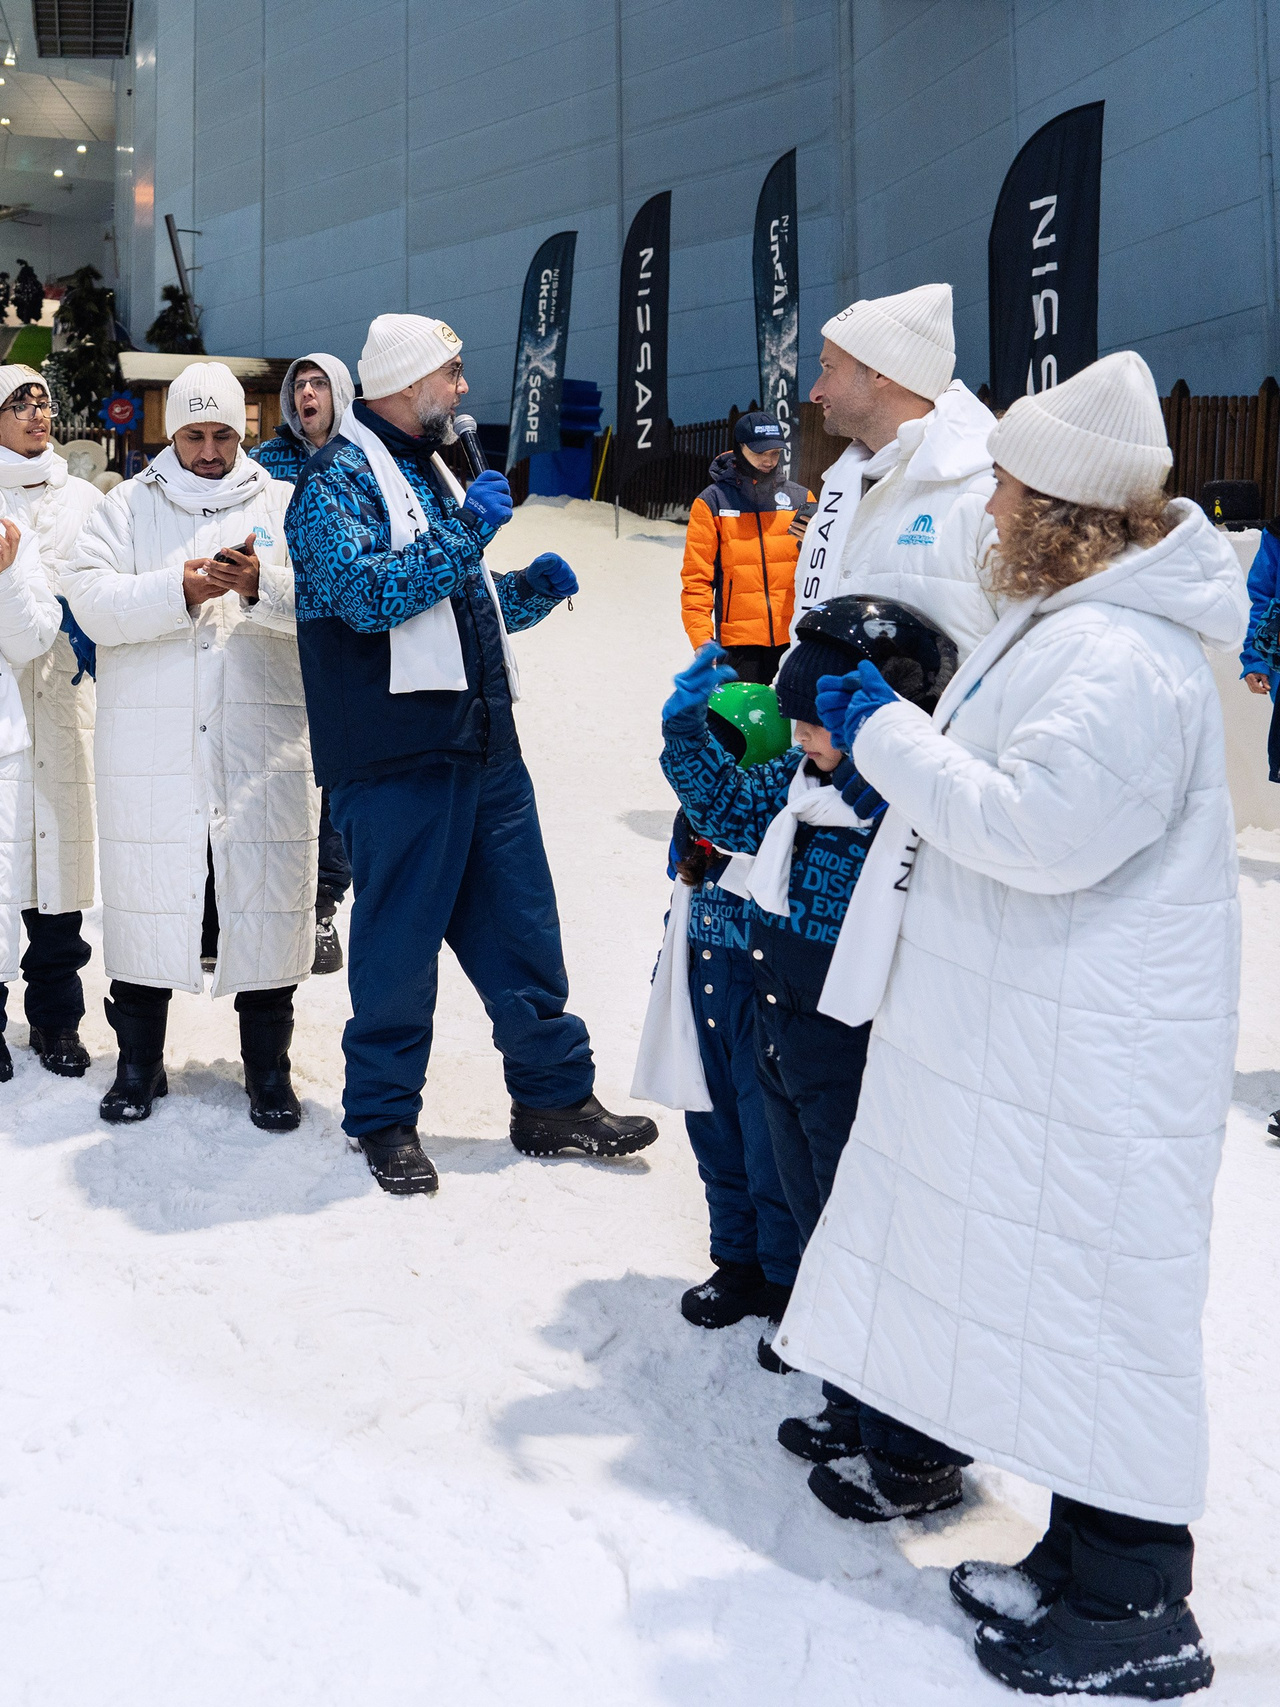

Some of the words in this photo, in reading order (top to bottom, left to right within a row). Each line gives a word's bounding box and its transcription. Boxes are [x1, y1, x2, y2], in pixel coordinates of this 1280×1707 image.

[1027, 195, 1058, 396] NISS
[635, 247, 654, 449] NISSAN
[189, 397, 219, 413] BA
[525, 374, 542, 443] SCAPE
[260, 449, 296, 464] ROLL
[801, 491, 843, 611] ISSAN
[341, 573, 369, 606] ENJOY
[809, 848, 854, 876] RIDE
